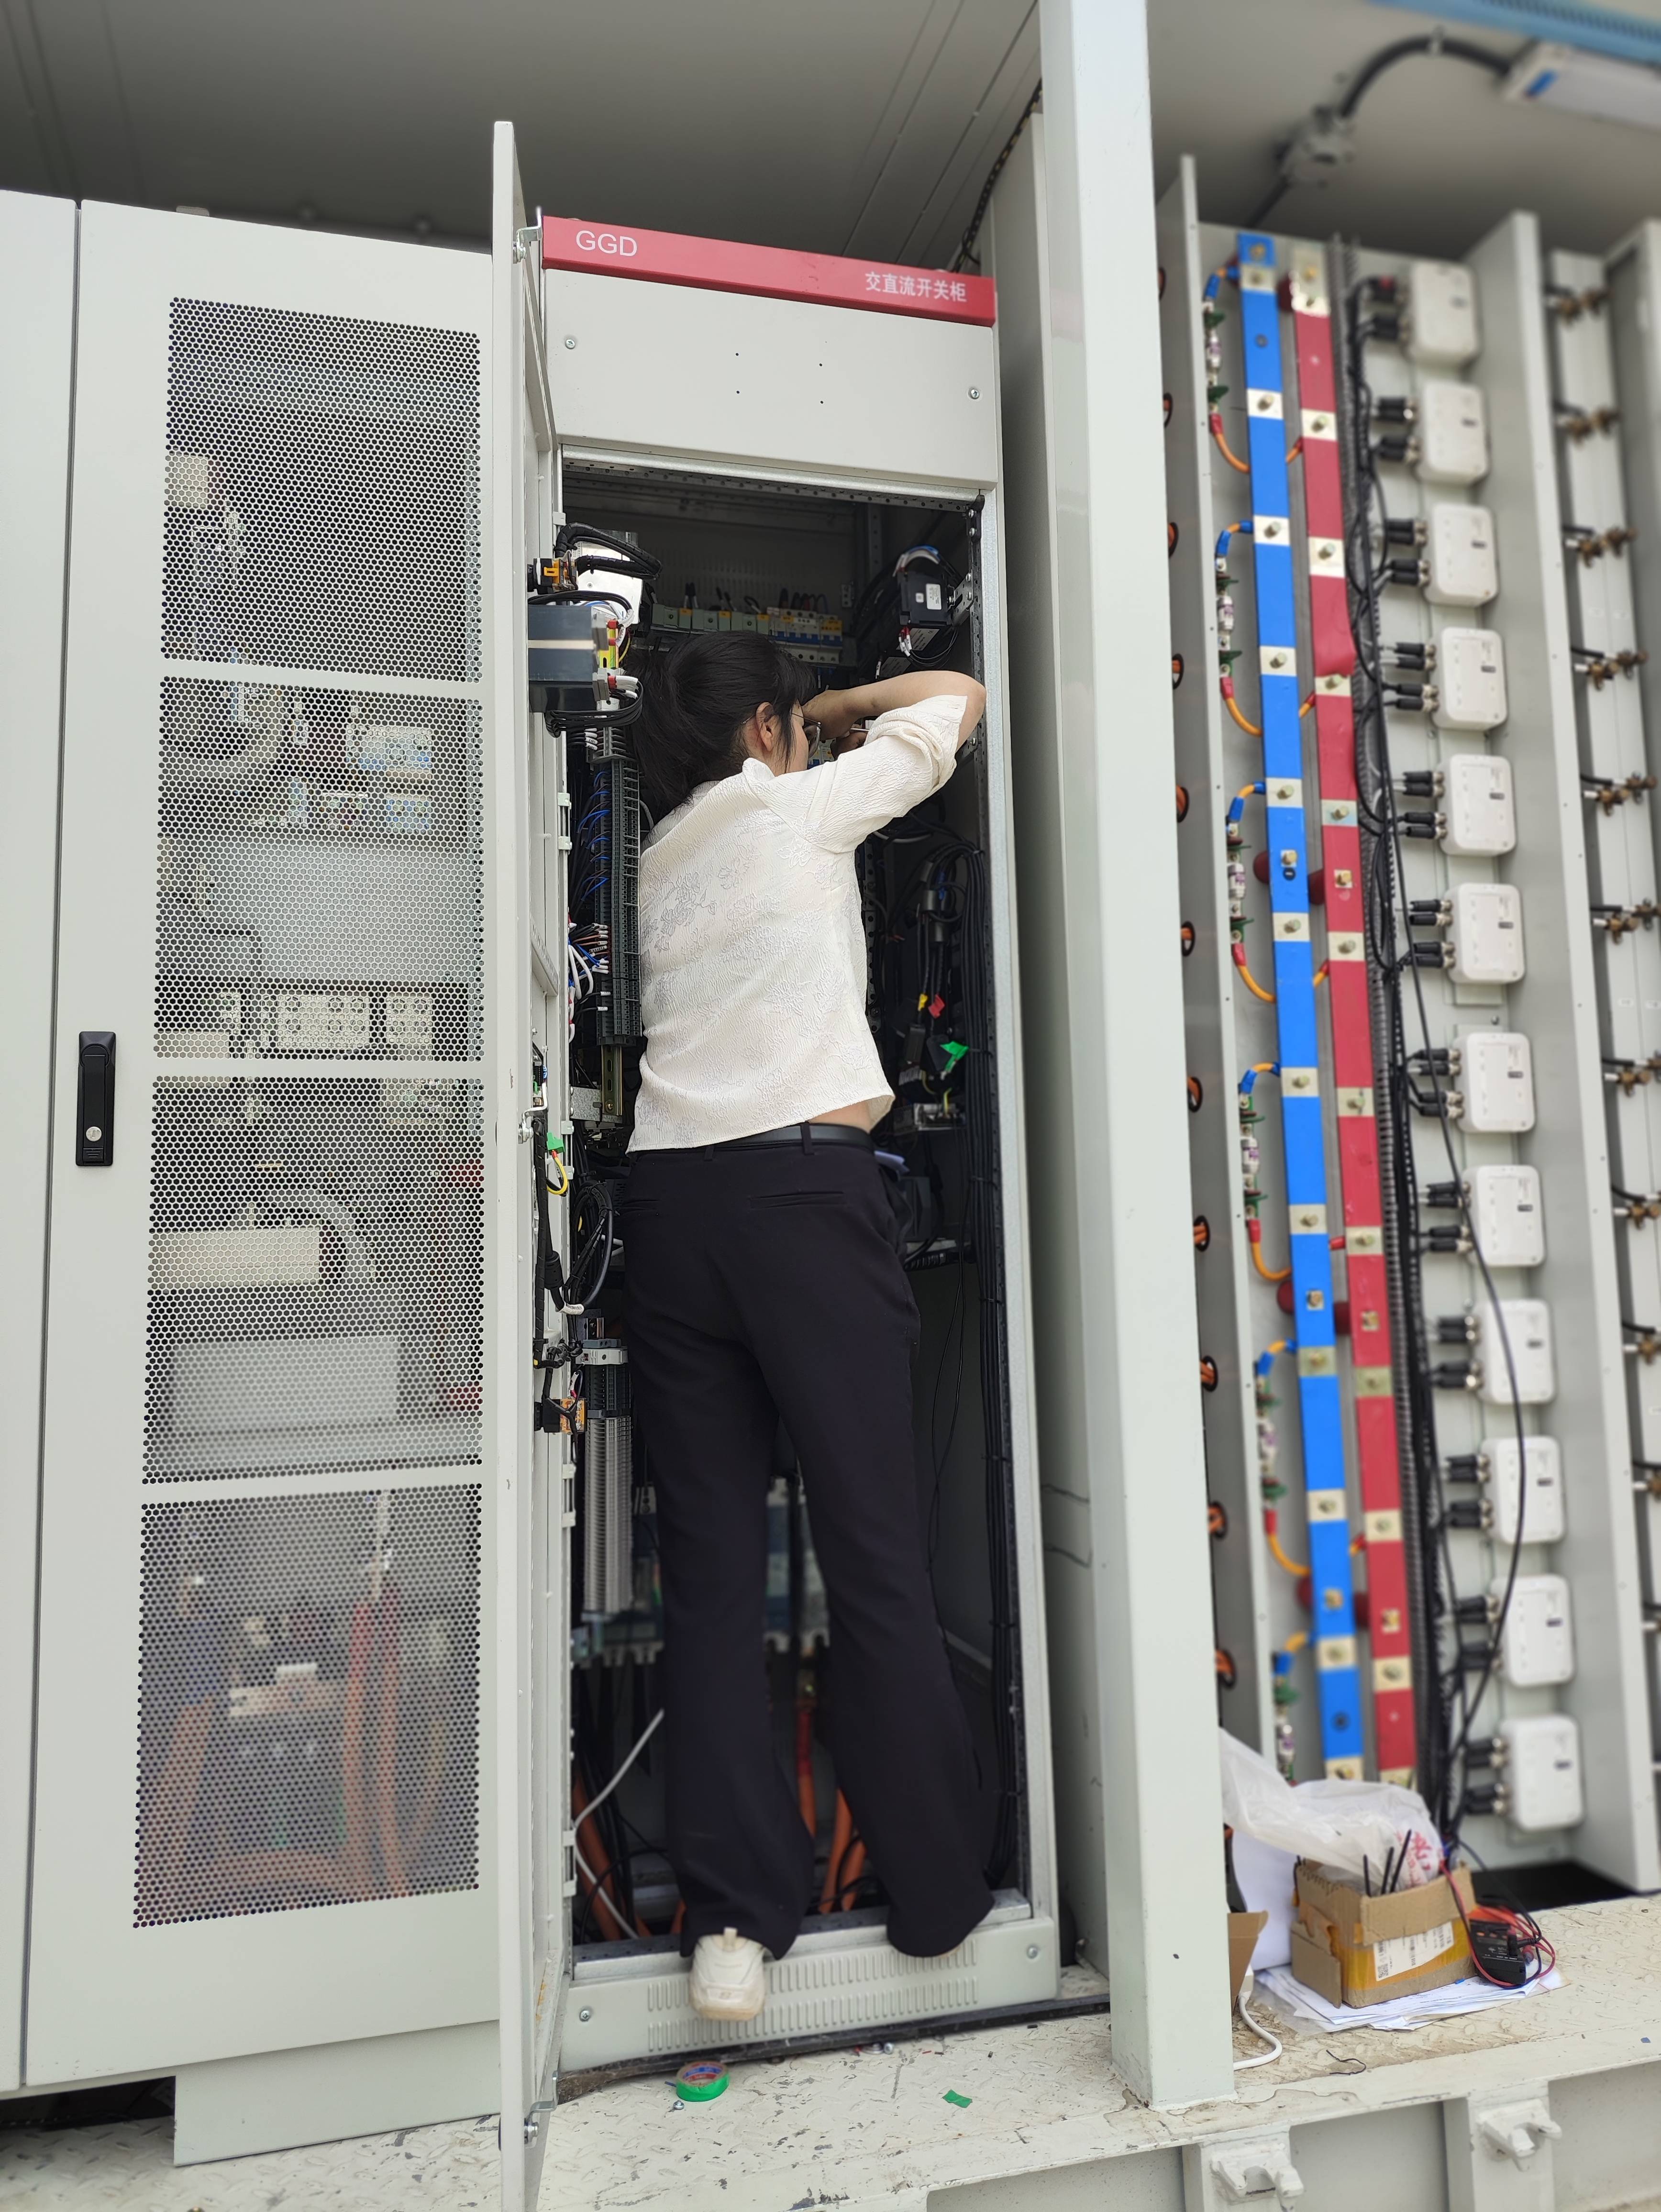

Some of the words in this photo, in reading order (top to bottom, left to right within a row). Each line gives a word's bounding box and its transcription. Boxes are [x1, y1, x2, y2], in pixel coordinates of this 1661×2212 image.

[576, 230, 638, 256] GGD
[864, 271, 967, 302] 交直流开关柜
